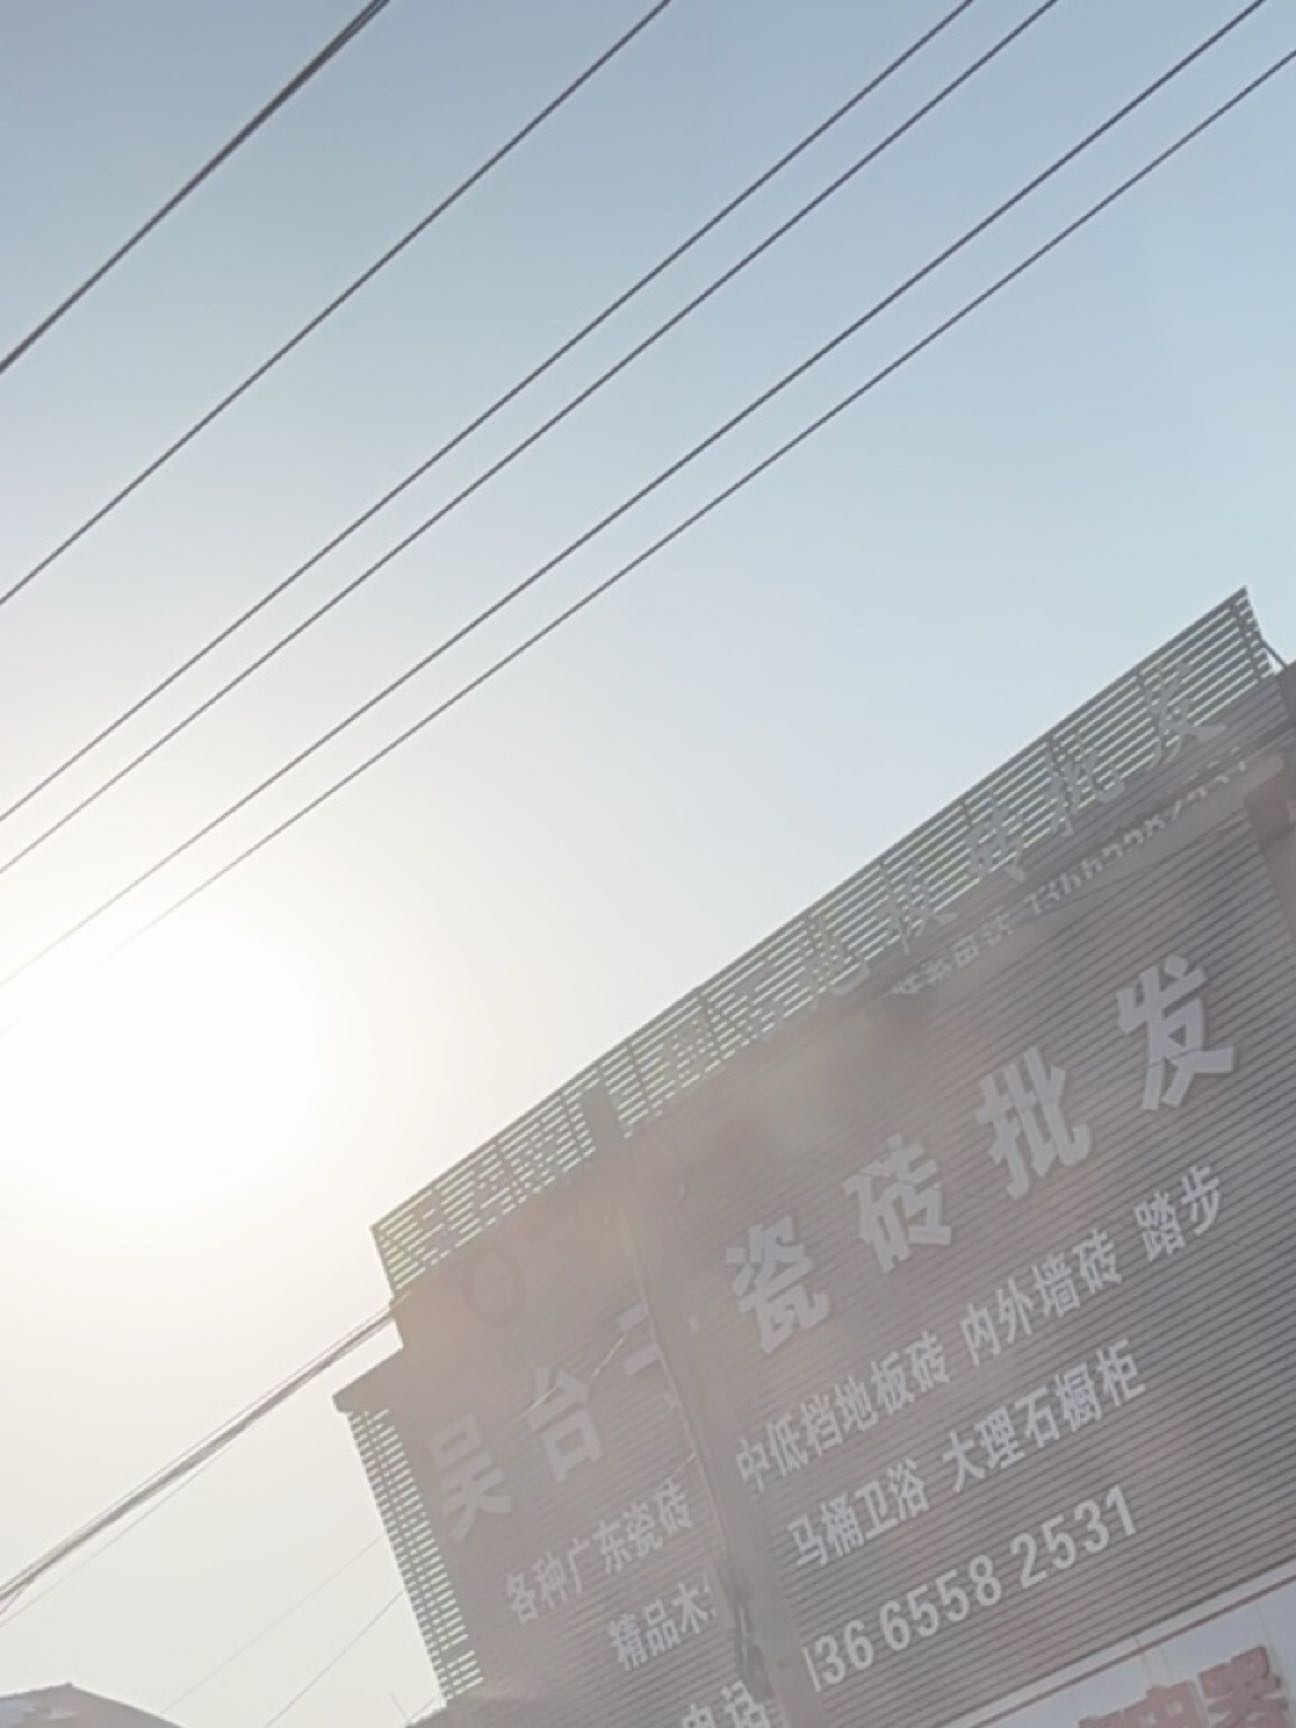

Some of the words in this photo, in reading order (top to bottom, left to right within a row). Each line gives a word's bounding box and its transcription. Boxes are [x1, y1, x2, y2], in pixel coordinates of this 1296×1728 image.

[505, 1477, 694, 1624] 各种广东瓷砖
[960, 1229, 1123, 1367] 内外墙砖
[1134, 1165, 1223, 1262] 踏步
[607, 1570, 718, 1674] 精品木
[786, 1459, 931, 1569] 马桶卫浴
[941, 1338, 1146, 1493] 大理石橱柜
[879, 1553, 1004, 1652] 6558
[1009, 1482, 1140, 1591] 2531
